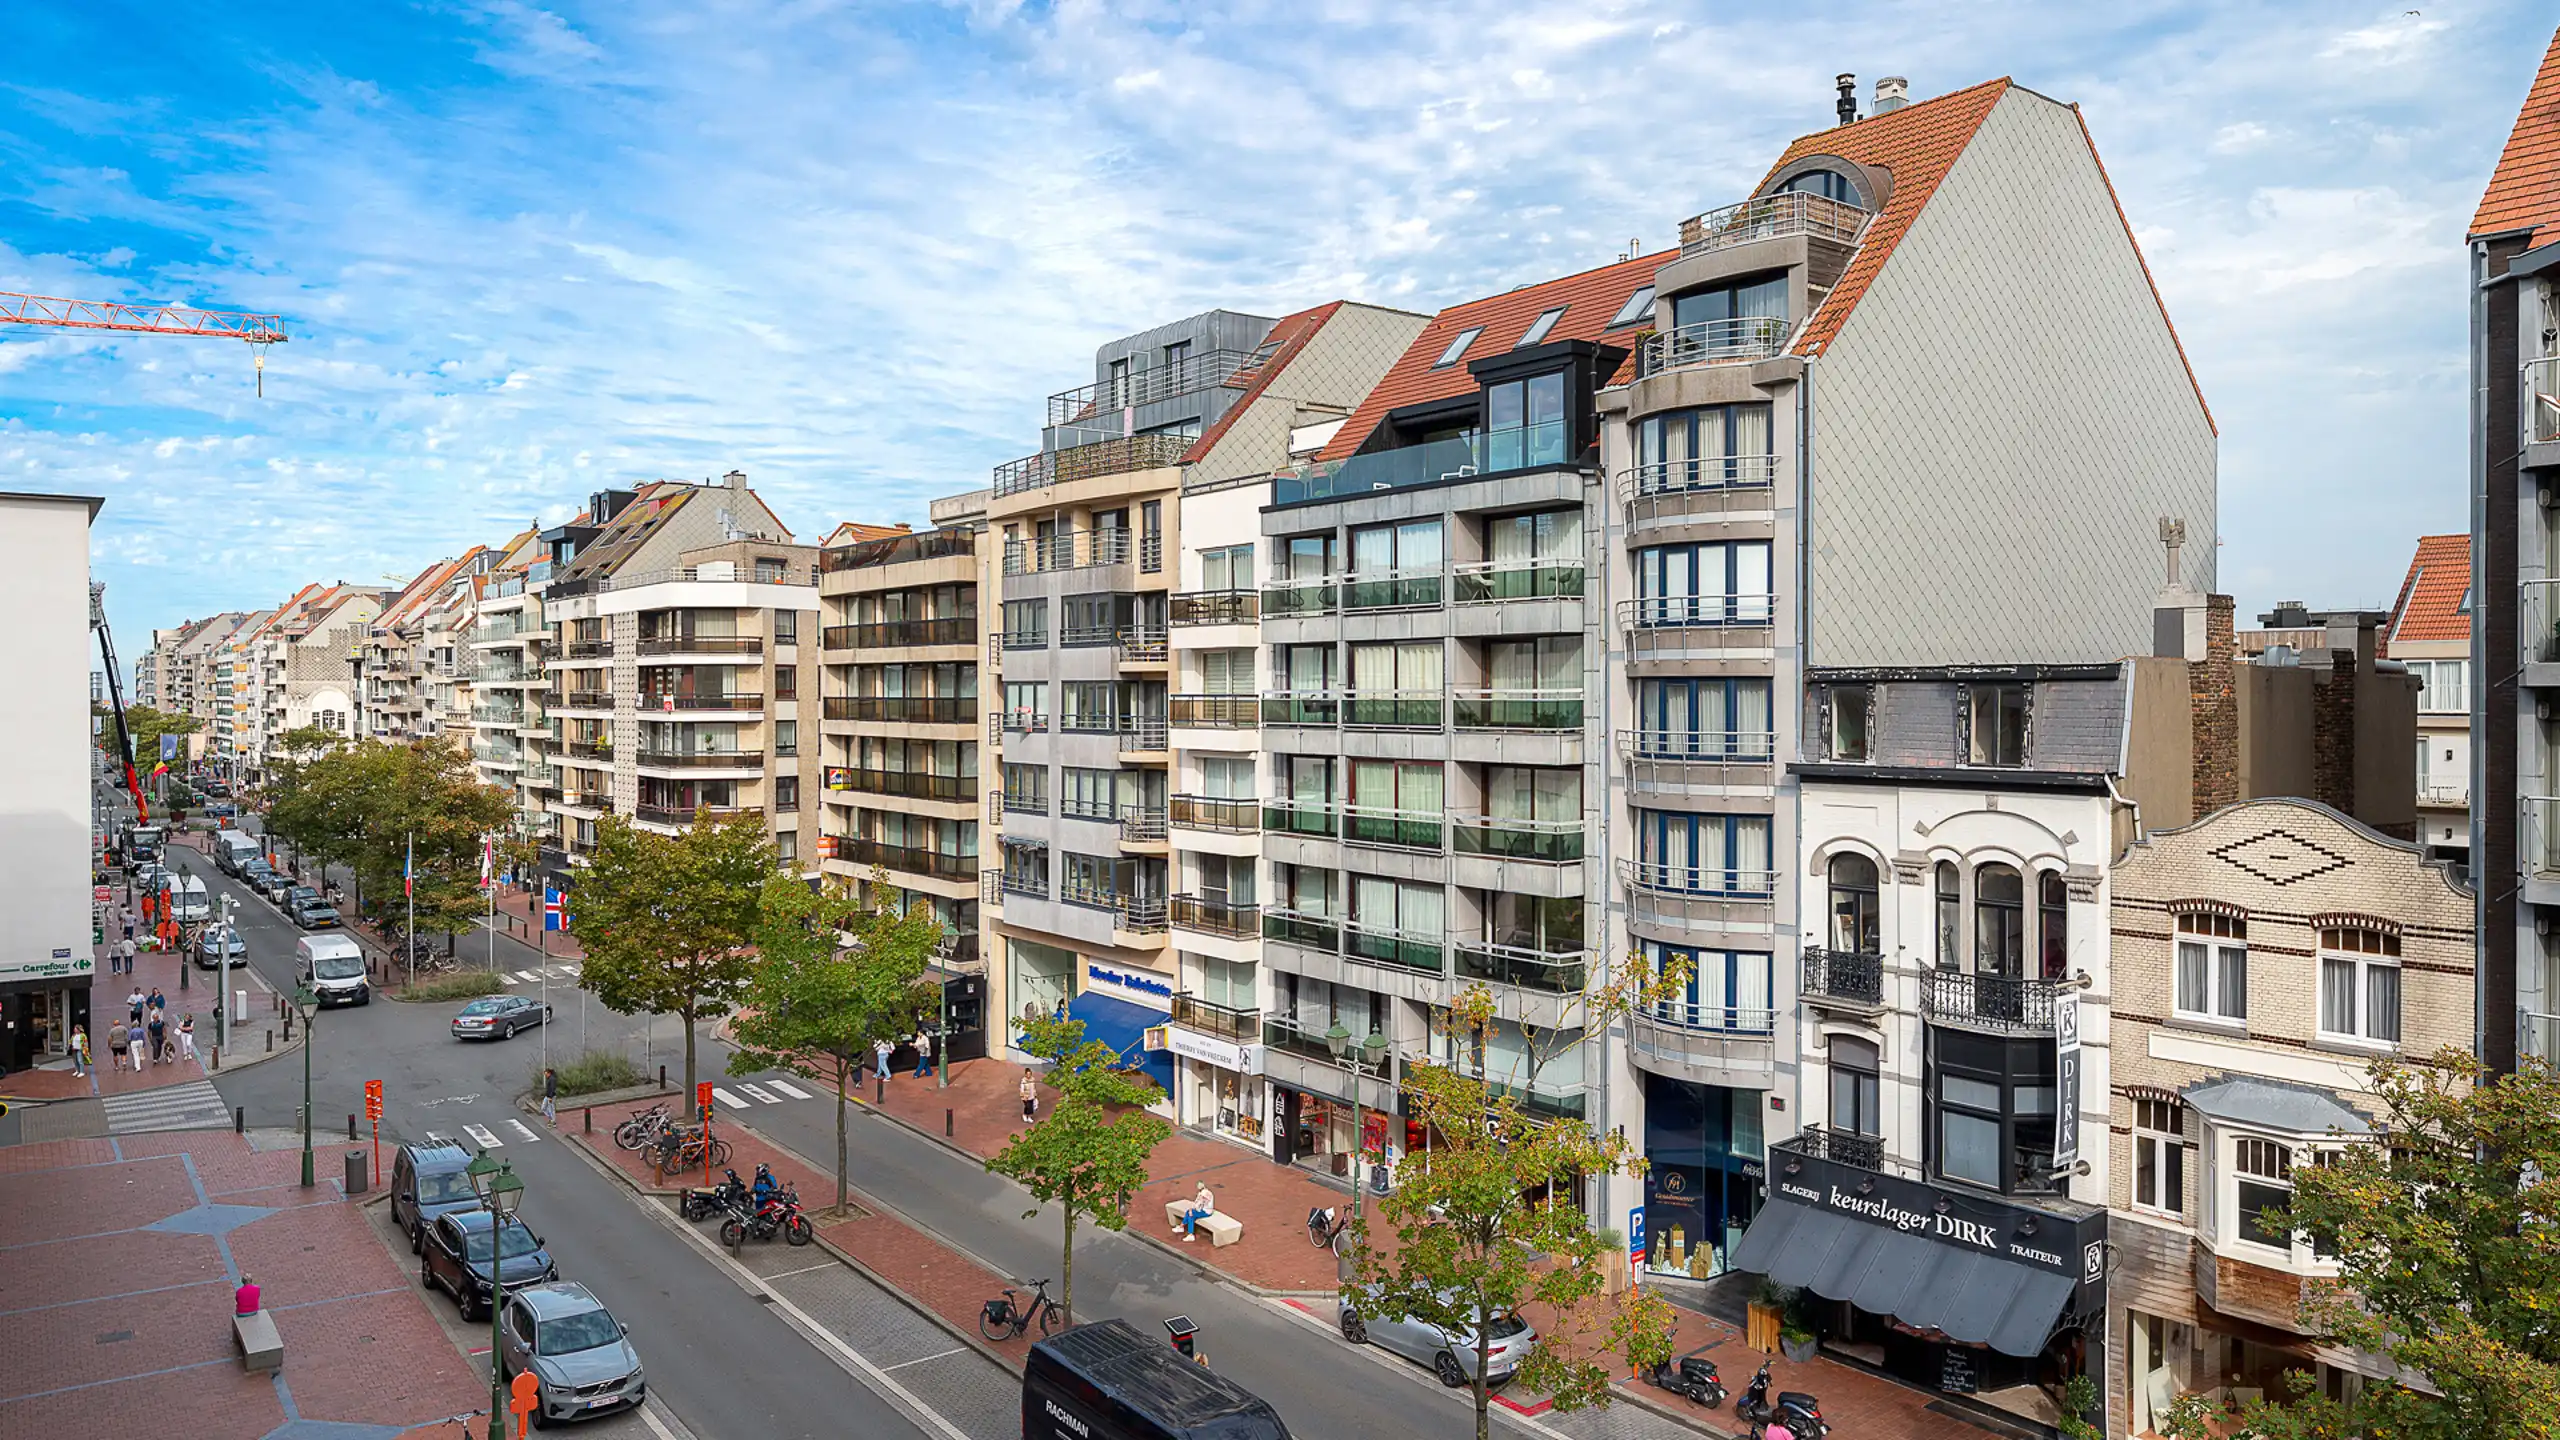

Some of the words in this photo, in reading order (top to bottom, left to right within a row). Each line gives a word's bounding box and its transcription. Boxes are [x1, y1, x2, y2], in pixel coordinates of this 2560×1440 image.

[22, 962, 70, 973] Carrefour
[2063, 1059, 2074, 1144] DIRK
[1781, 1182, 1821, 1203] SLAGERIJ
[1829, 1185, 1932, 1231] keurslager
[1935, 1213, 1998, 1249] DIRK
[2010, 1243, 2063, 1267] TRAITEUR
[2088, 1252, 2098, 1270] K
[1045, 1399, 1089, 1439] RACHMAN
